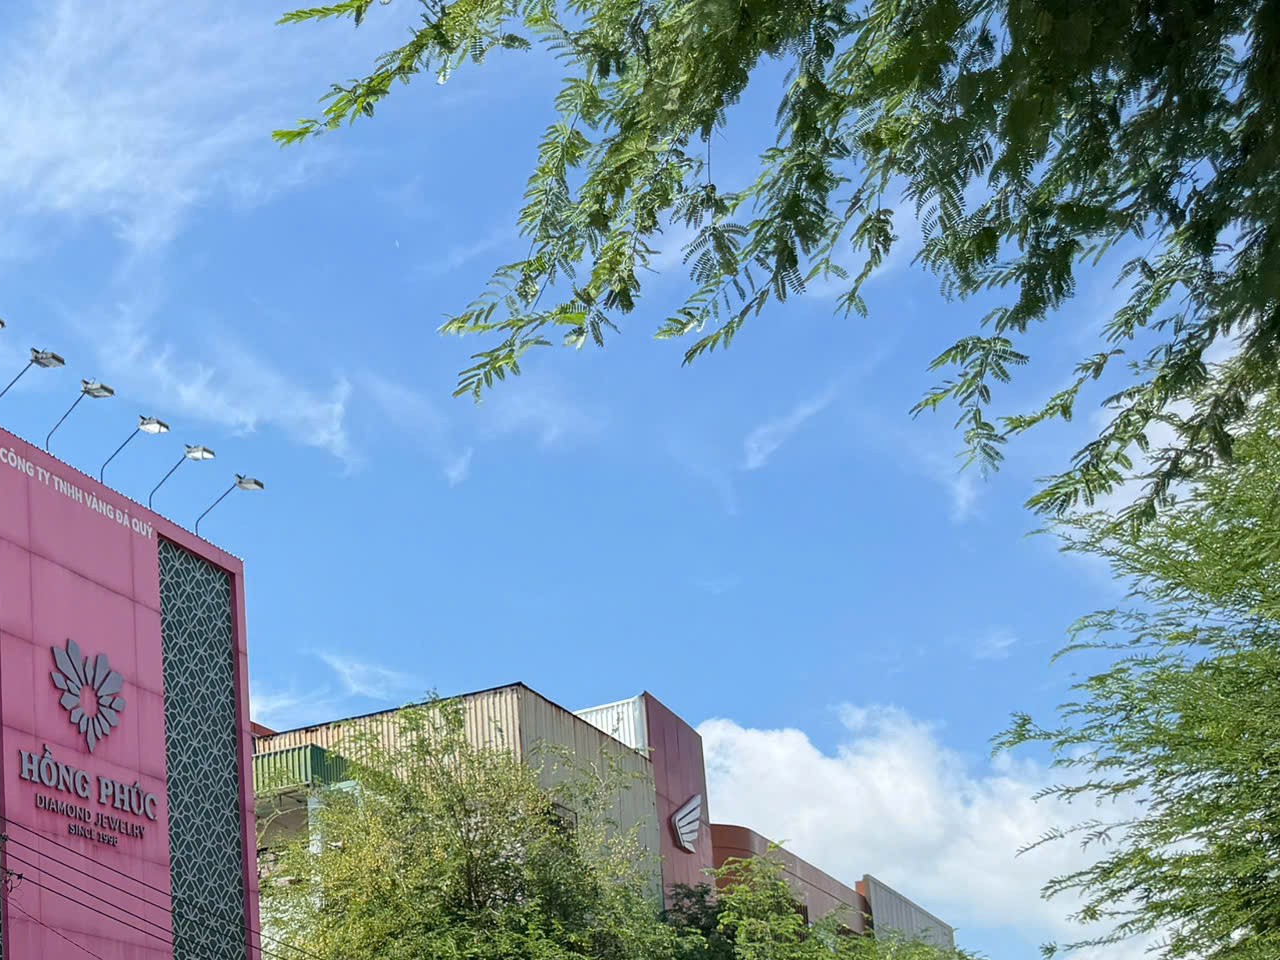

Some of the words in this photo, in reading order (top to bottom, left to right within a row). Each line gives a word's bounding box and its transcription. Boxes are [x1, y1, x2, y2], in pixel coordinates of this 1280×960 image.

[0, 447, 34, 477] CÔNG
[36, 466, 51, 485] TY
[53, 476, 83, 503] TNHH
[84, 492, 115, 519] VÀNG
[116, 509, 130, 528] ĐÁ
[132, 517, 153, 539] QUÝ
[19, 744, 91, 800] HỒNG
[97, 775, 158, 821] PHÚC
[35, 793, 92, 823] DIAMOND
[95, 812, 145, 839] JEWELRY
[68, 823, 96, 840] SINCE
